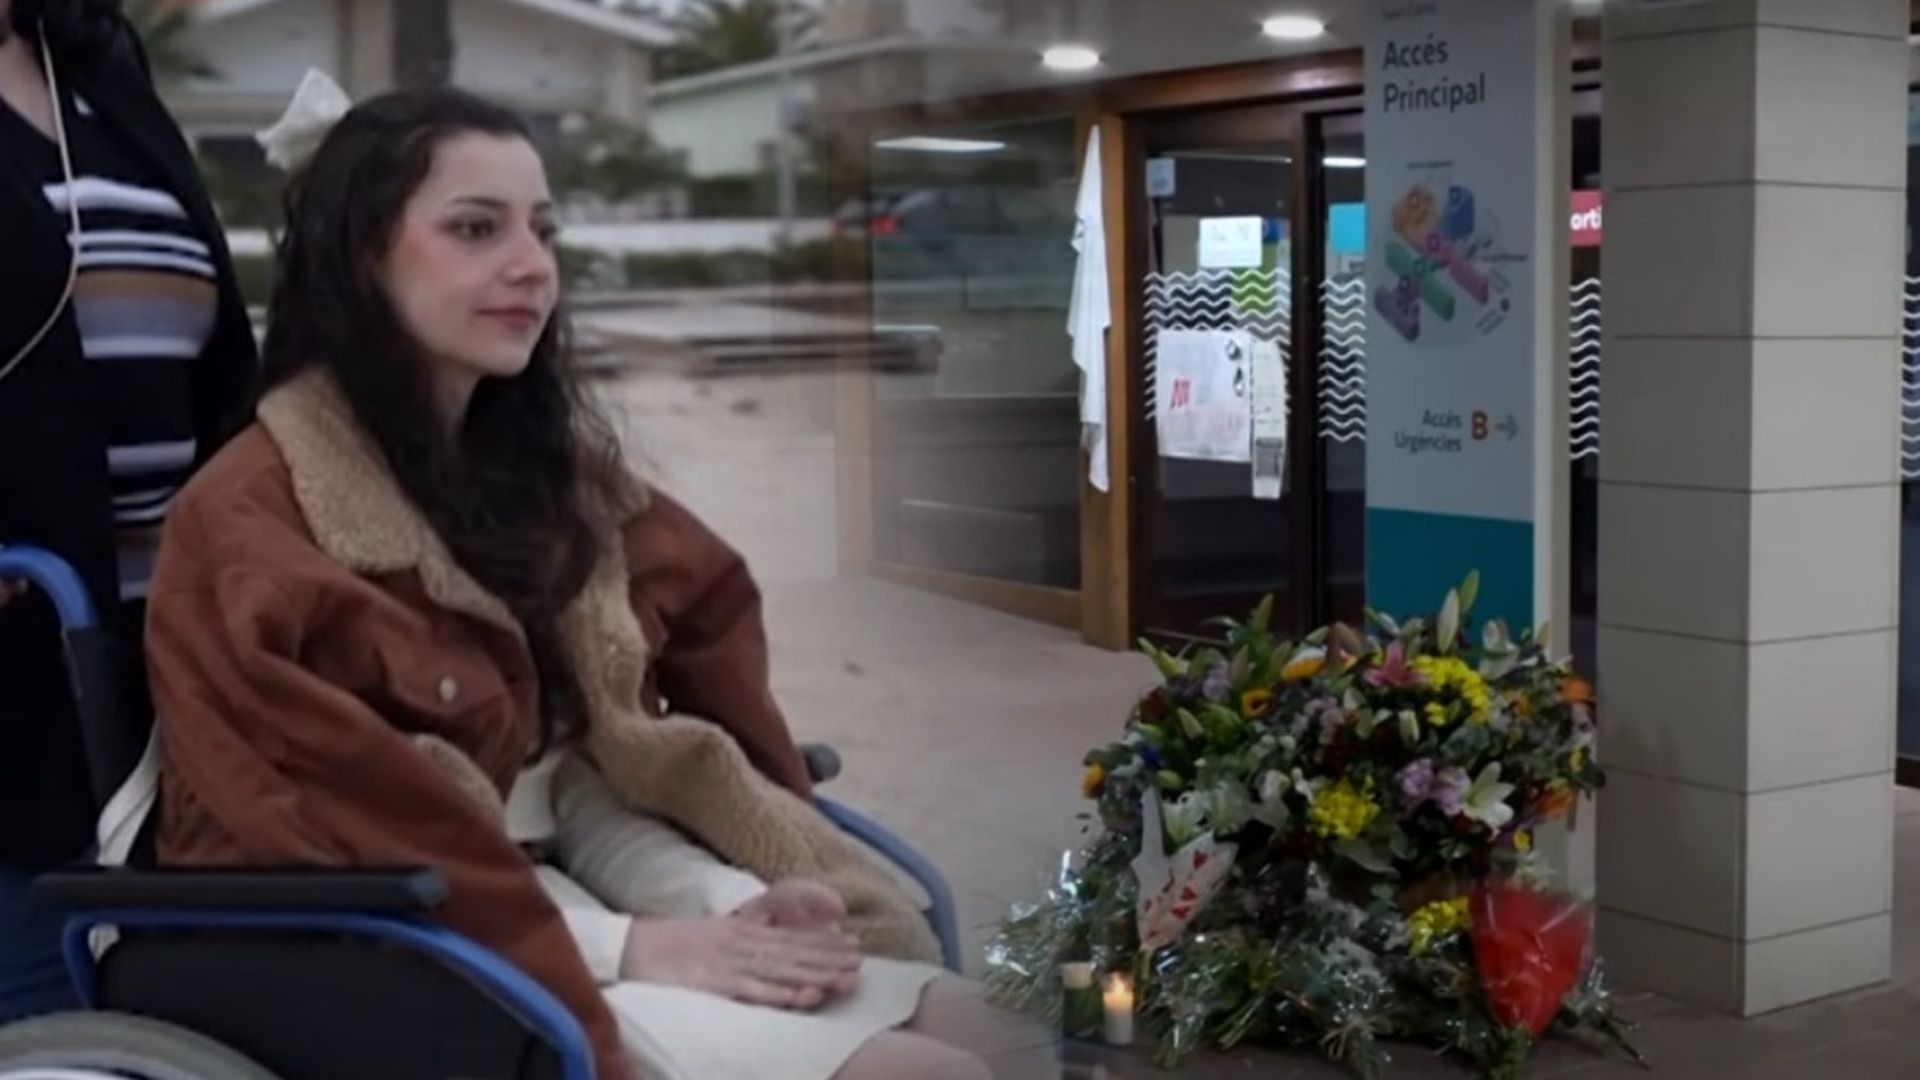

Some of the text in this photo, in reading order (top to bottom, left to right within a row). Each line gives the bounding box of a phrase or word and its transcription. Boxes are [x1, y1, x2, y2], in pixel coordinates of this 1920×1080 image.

[1383, 33, 1448, 69] Accés
[1384, 72, 1485, 112] Principal
[1471, 410, 1488, 440] B
